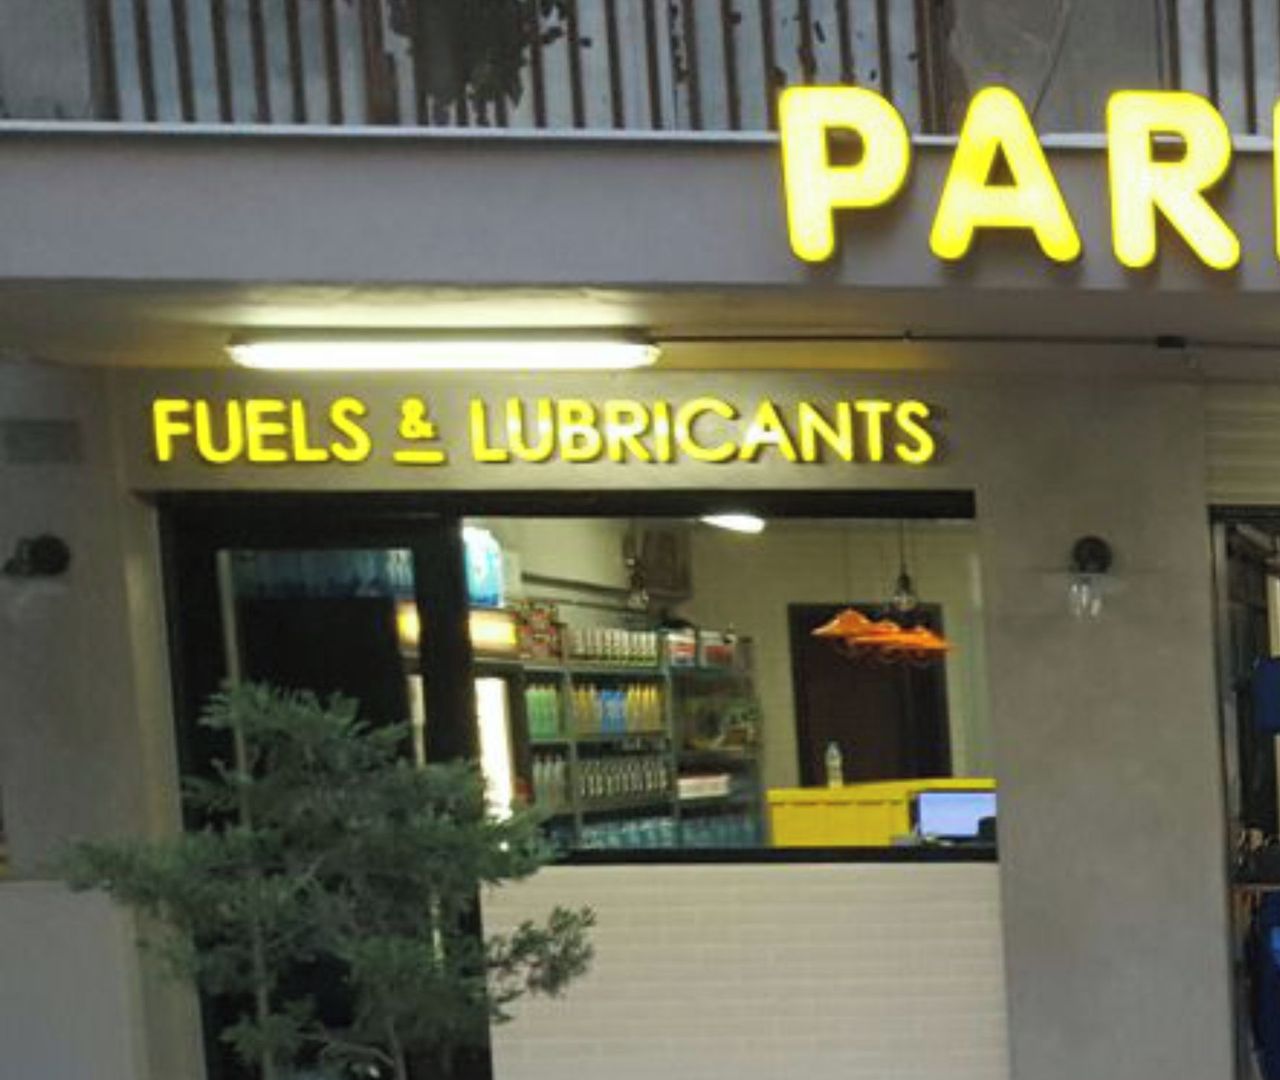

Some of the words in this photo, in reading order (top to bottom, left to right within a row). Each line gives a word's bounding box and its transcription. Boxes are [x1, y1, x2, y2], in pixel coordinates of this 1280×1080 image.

[153, 396, 372, 463] FUELS
[391, 396, 445, 463] &
[464, 389, 934, 465] LUBRICANTS
